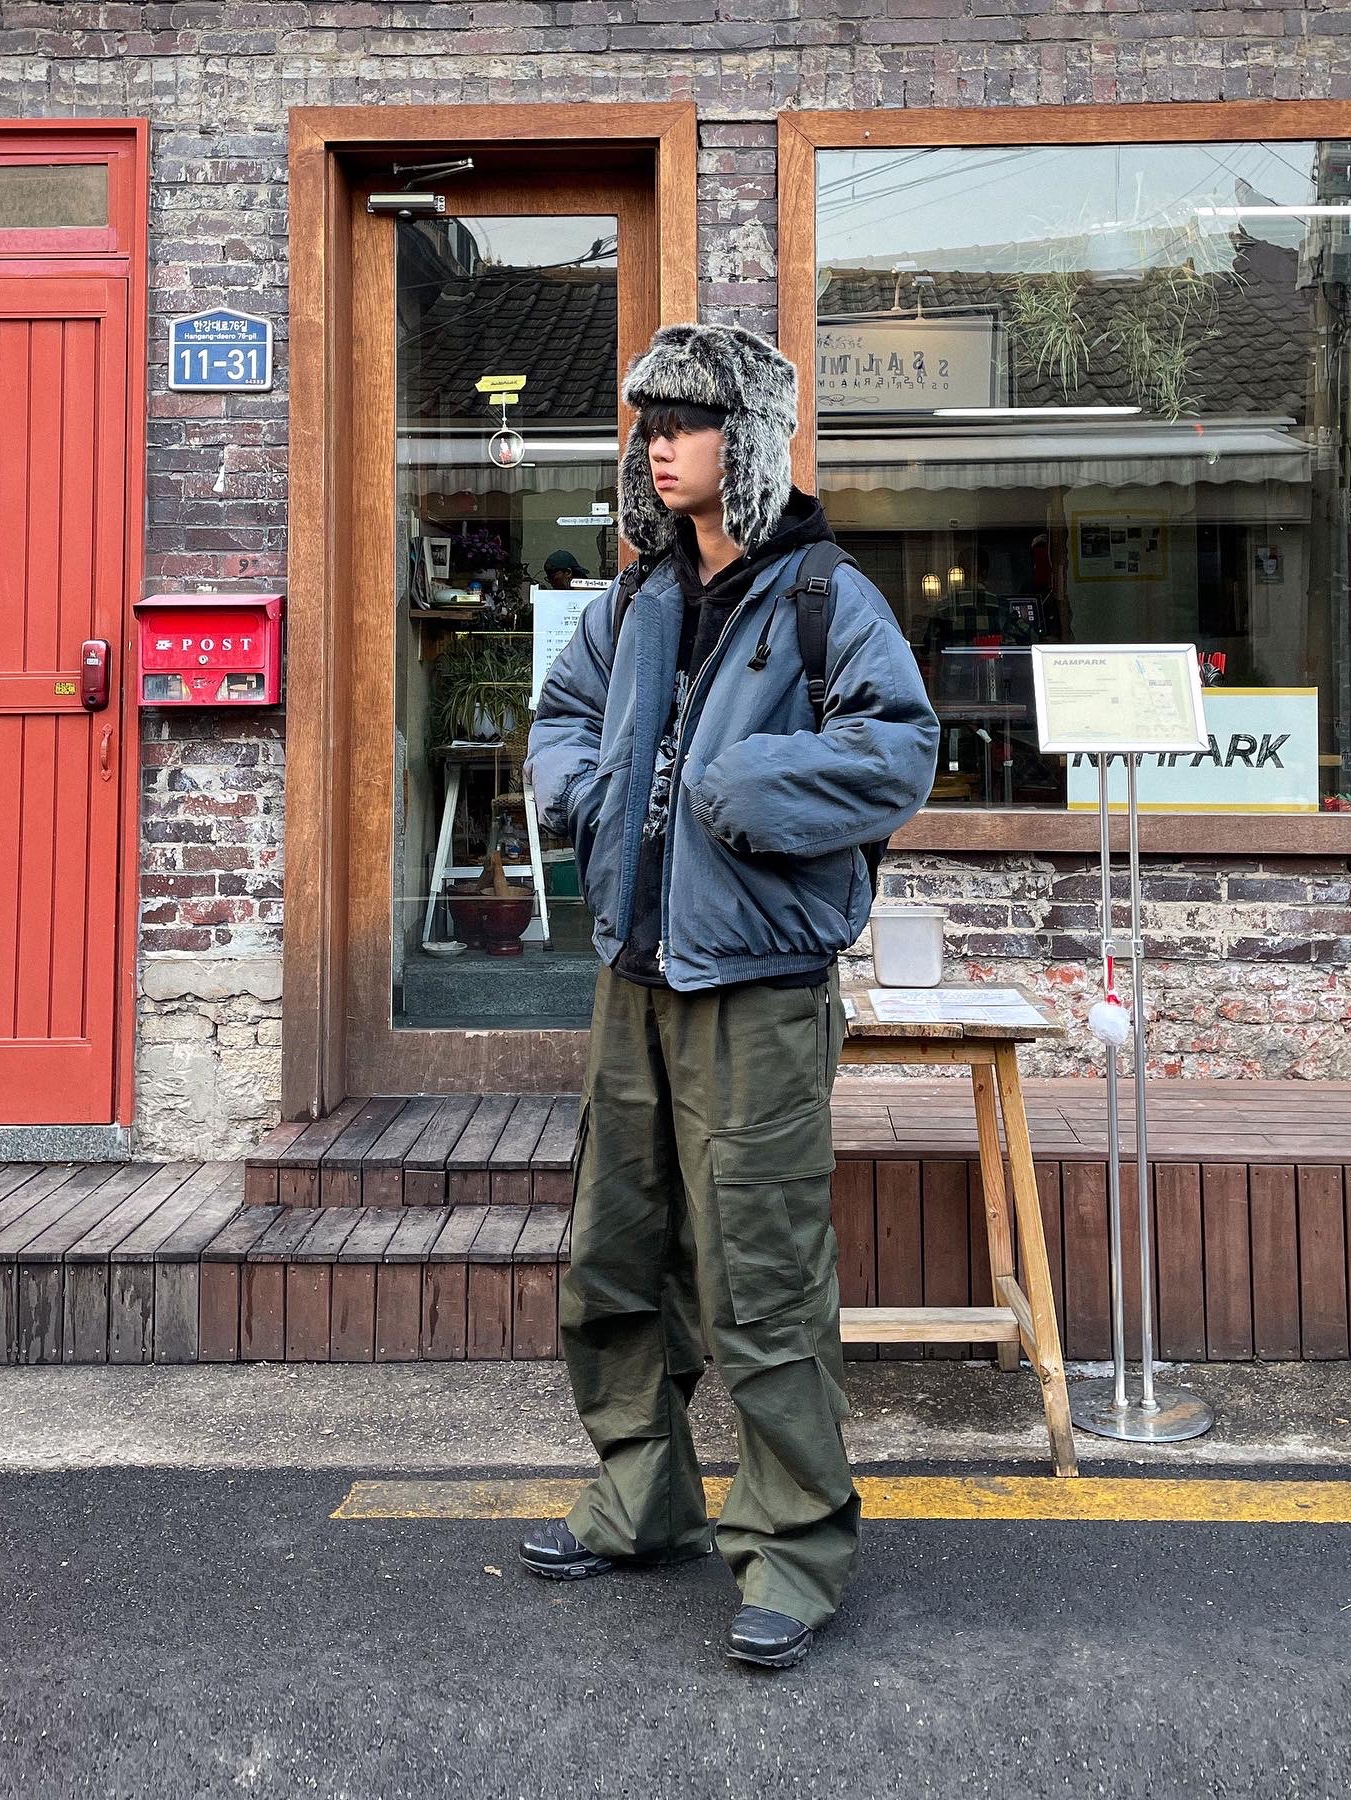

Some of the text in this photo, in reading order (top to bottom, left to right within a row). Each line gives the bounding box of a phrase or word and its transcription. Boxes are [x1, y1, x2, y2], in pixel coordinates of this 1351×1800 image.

[193, 320, 248, 332] 한강대로76길
[184, 332, 236, 341] Hangang-daero
[180, 349, 257, 380] 11-31
[181, 638, 253, 651] POST
